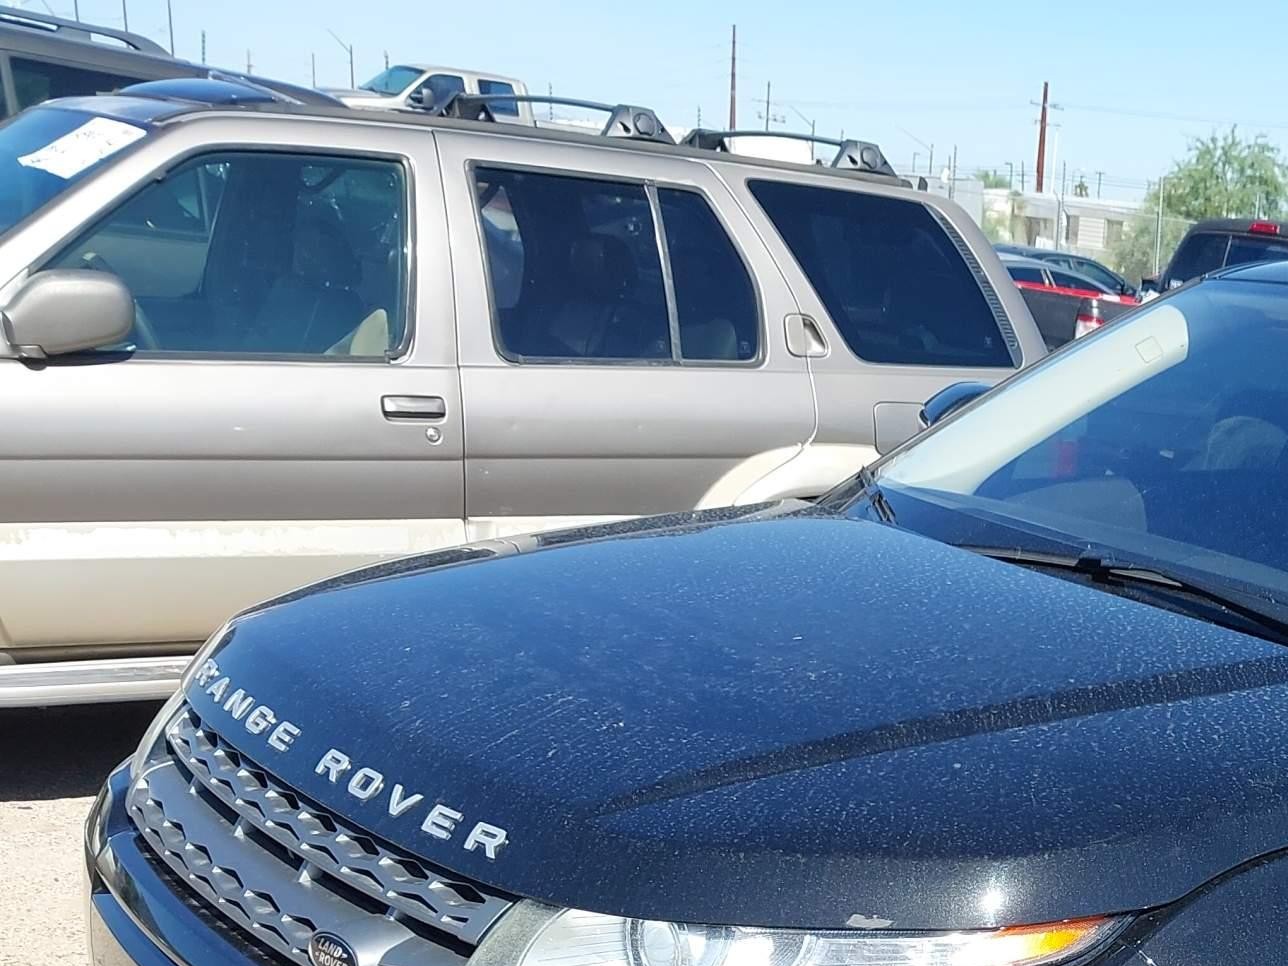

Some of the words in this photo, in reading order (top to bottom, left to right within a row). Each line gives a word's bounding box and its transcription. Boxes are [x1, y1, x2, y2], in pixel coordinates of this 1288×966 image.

[194, 657, 302, 752] RANGE
[314, 748, 509, 860] ROVER
[317, 937, 343, 958] LAND
